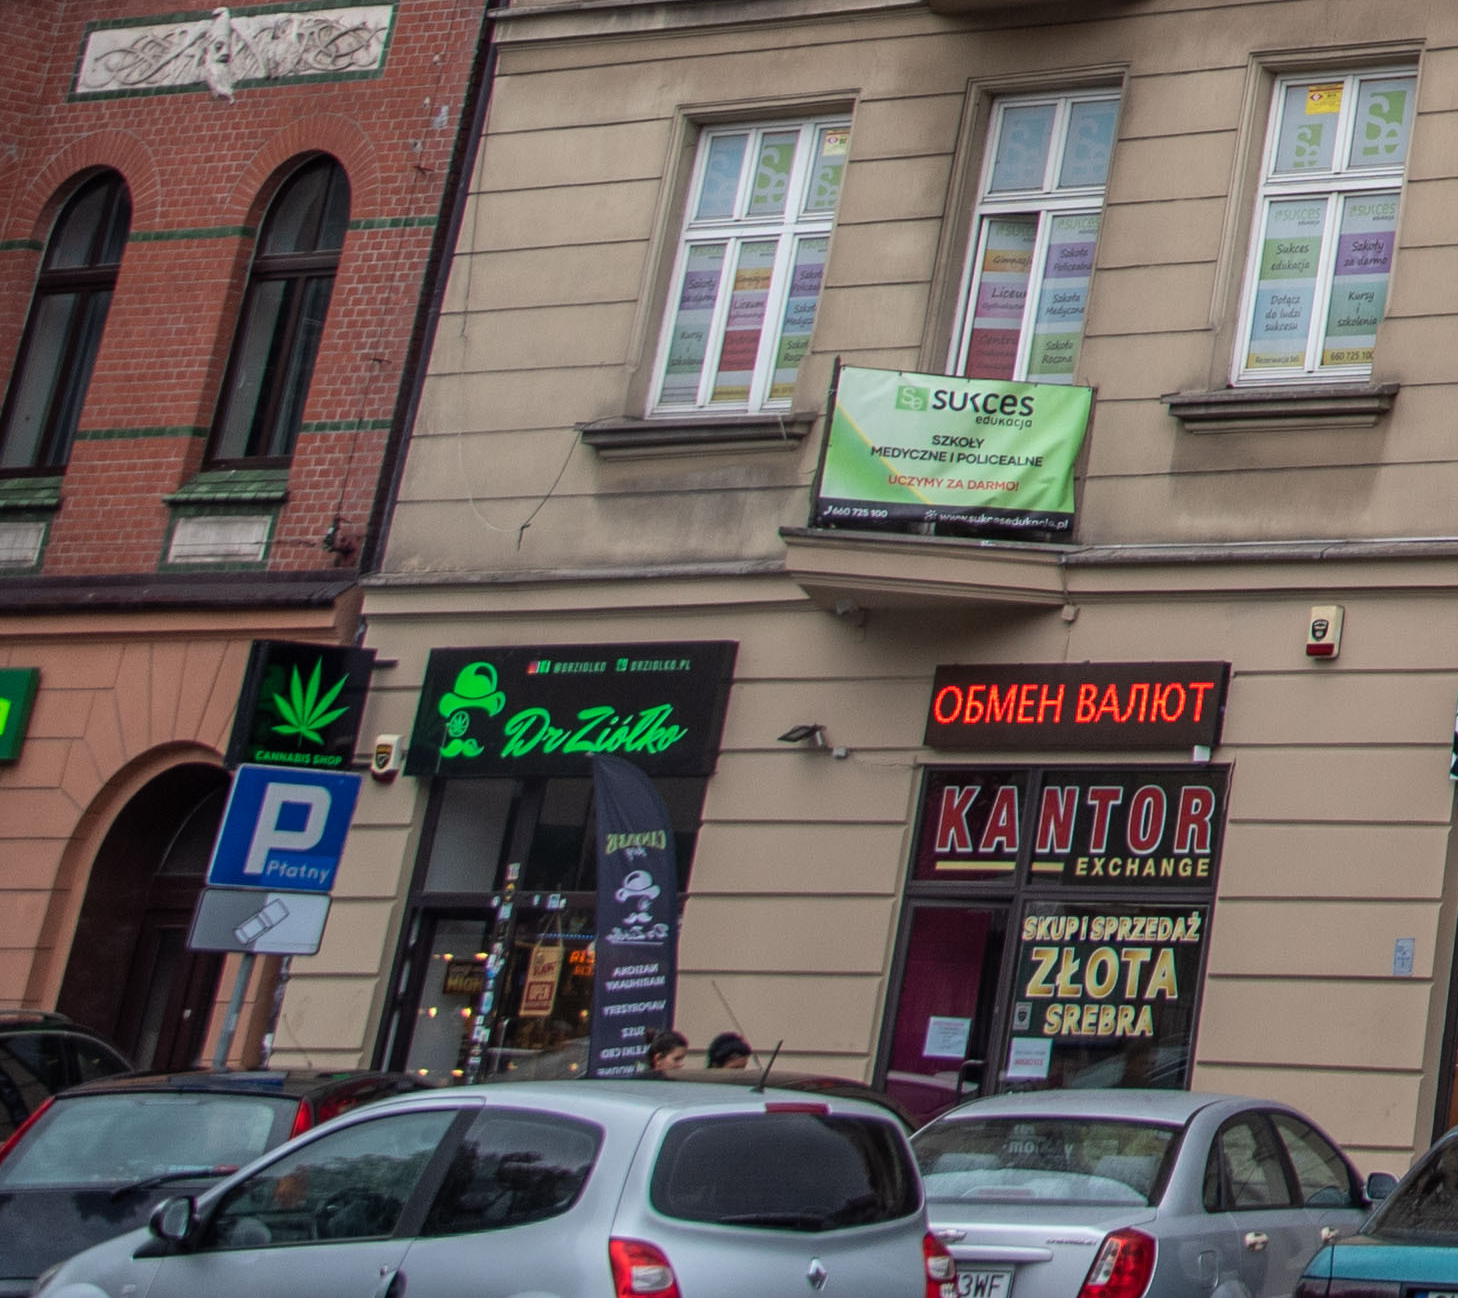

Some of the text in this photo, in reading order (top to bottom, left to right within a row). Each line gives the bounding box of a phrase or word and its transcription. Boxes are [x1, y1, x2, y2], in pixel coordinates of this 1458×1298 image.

[1276, 243, 1310, 254] Sukces
[1352, 241, 1385, 255] Szkoły
[1348, 291, 1375, 304] Kursy
[975, 415, 1032, 430] edukacja
[932, 435, 985, 449] SZKOŁY
[870, 446, 947, 463] MEDYCZNE
[956, 452, 1044, 467] POLICEALNE
[888, 474, 1019, 491] UCZYMY ZA DARMO!
[831, 507, 888, 519] 660 725 100
[933, 682, 1215, 724] ОБМЕН ВАЛЮТ
[255, 750, 343, 767] CANNABIS SHOP
[243, 782, 332, 874] P
[935, 785, 1215, 855] KANTOR
[266, 860, 331, 885] Płatny
[1075, 858, 1211, 877] EXCHANGE
[1022, 916, 1080, 941] SKUP
[1090, 911, 1202, 942] SPRZEDAŻ
[1025, 946, 1179, 999] ZŁOTA
[1044, 1004, 1154, 1036] SREBRA
[958, 1273, 1004, 1298] 3WF
